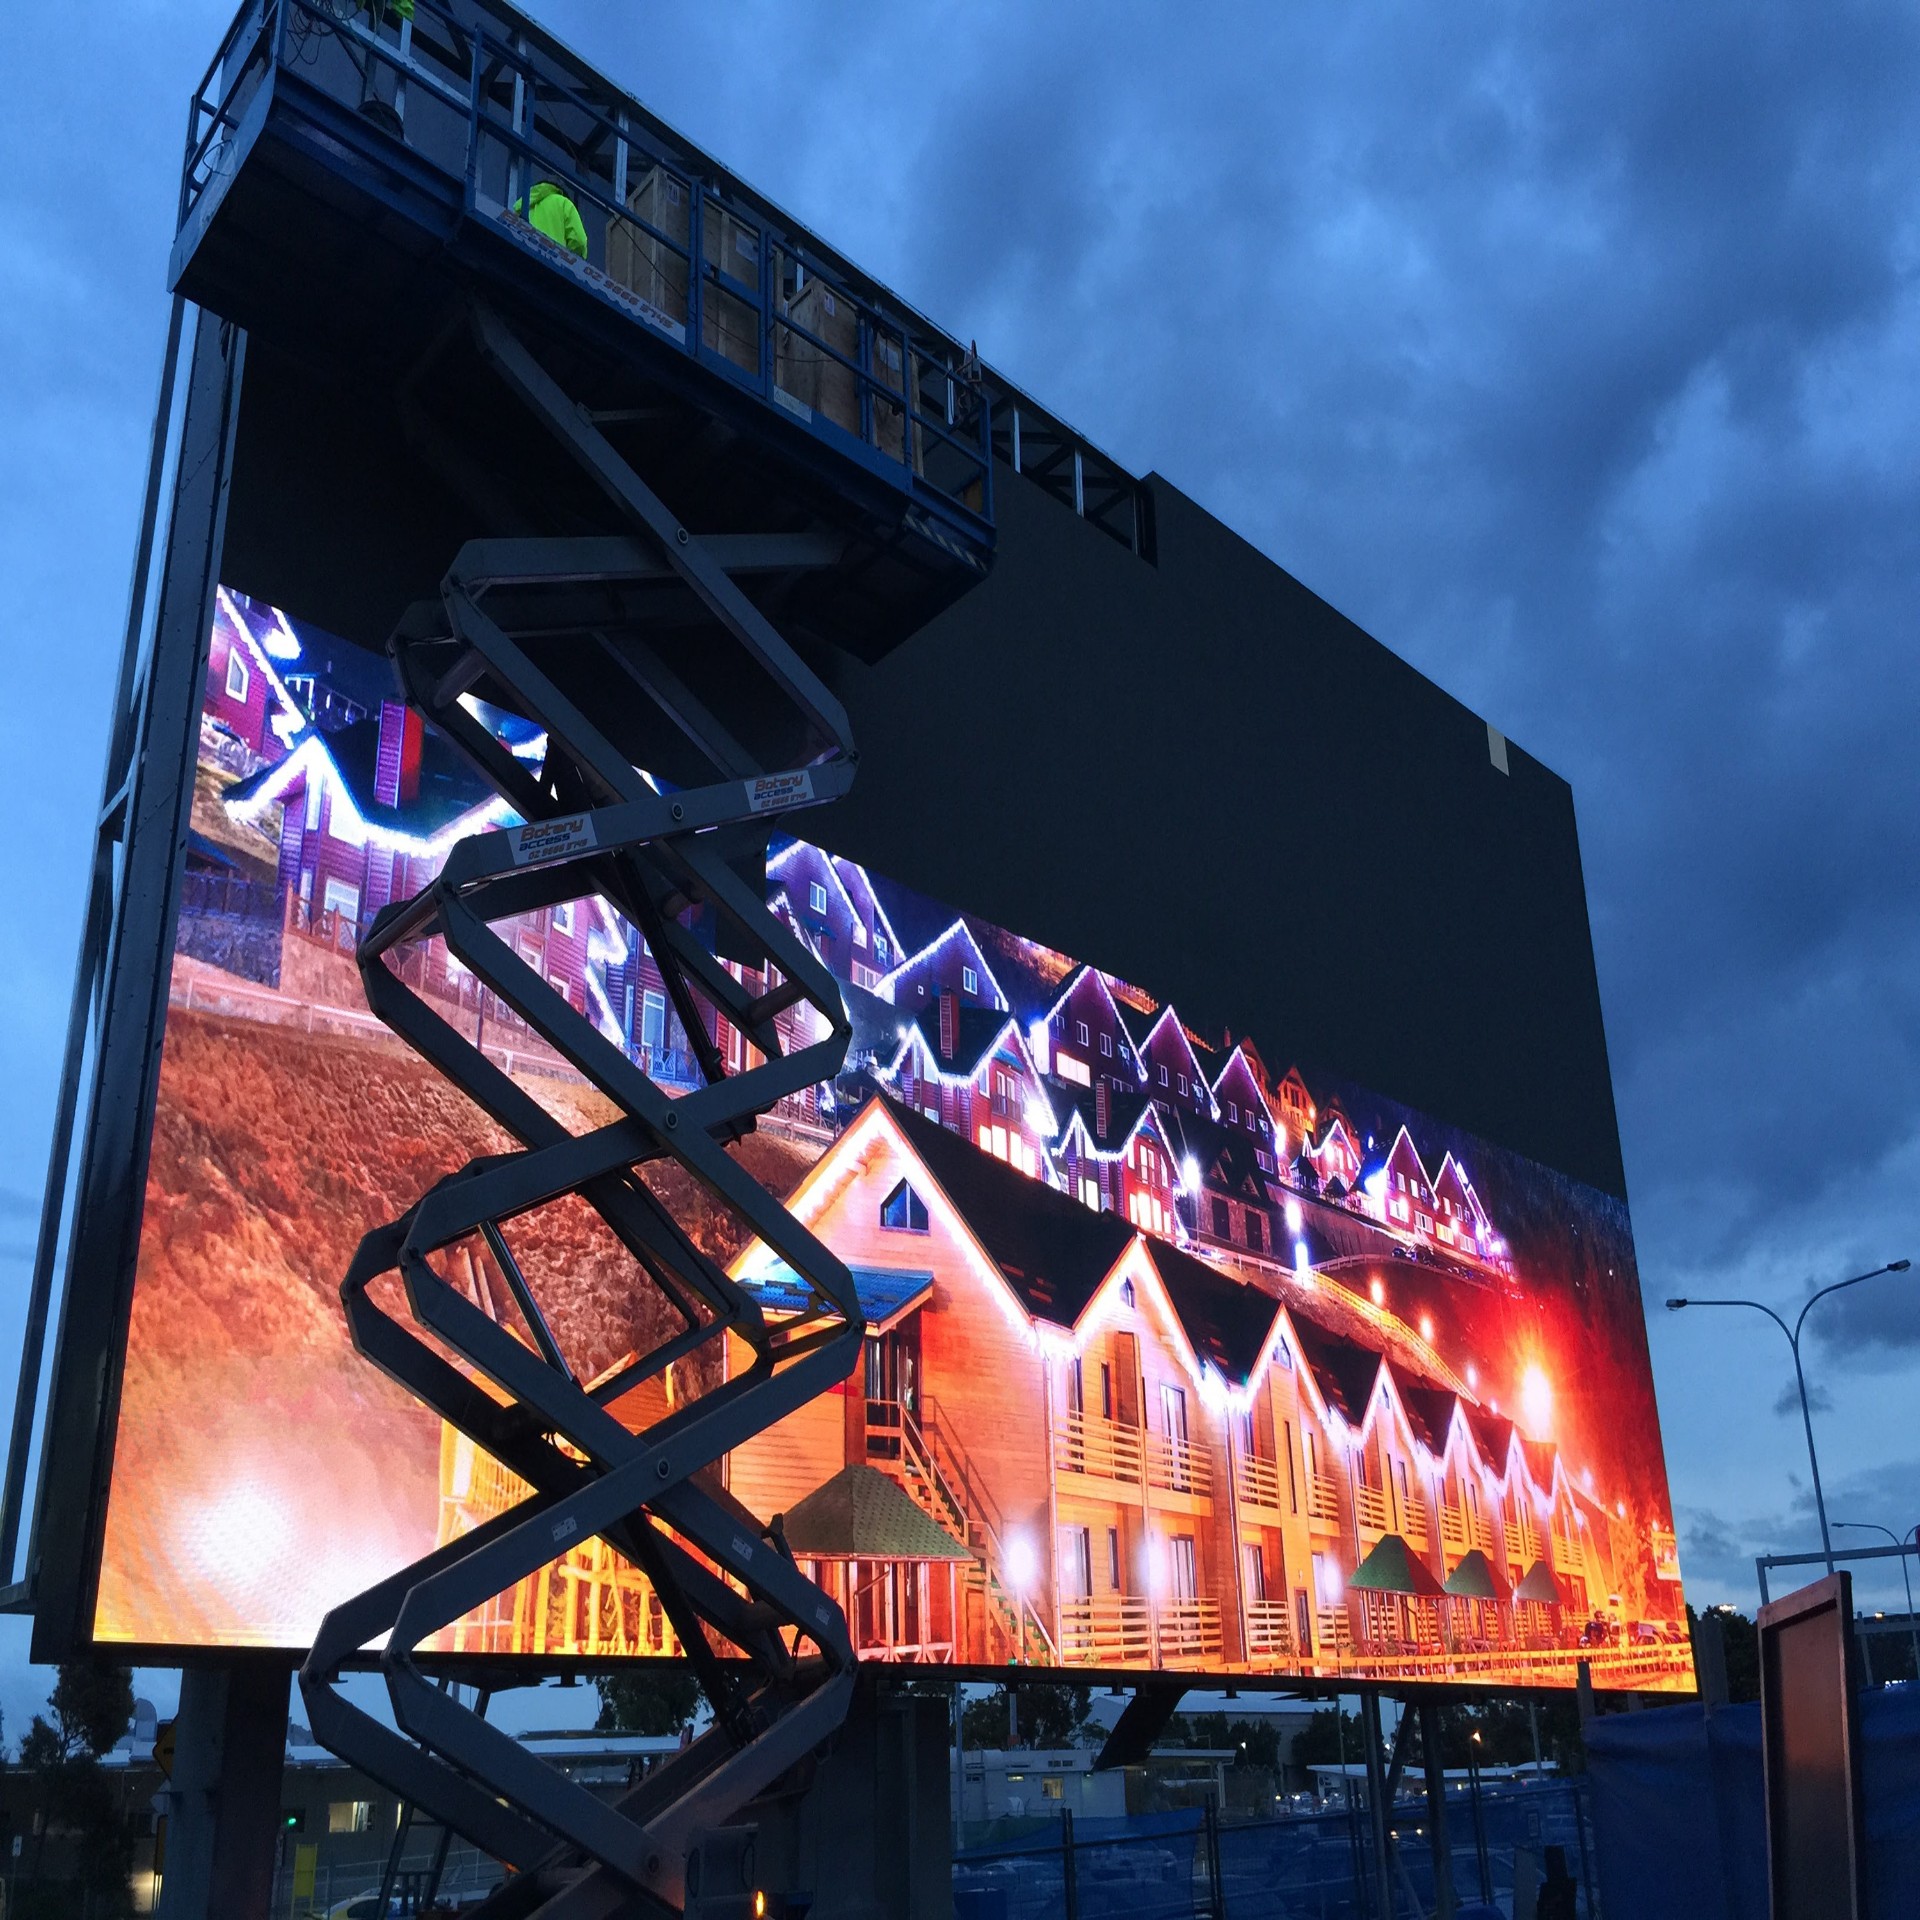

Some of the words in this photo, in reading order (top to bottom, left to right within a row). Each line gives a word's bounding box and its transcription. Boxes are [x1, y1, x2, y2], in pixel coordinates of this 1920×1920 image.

[583, 266, 603, 281] 02
[755, 775, 804, 792] Botany
[753, 786, 794, 800] access
[520, 818, 584, 842] Botany
[519, 832, 571, 851] access
